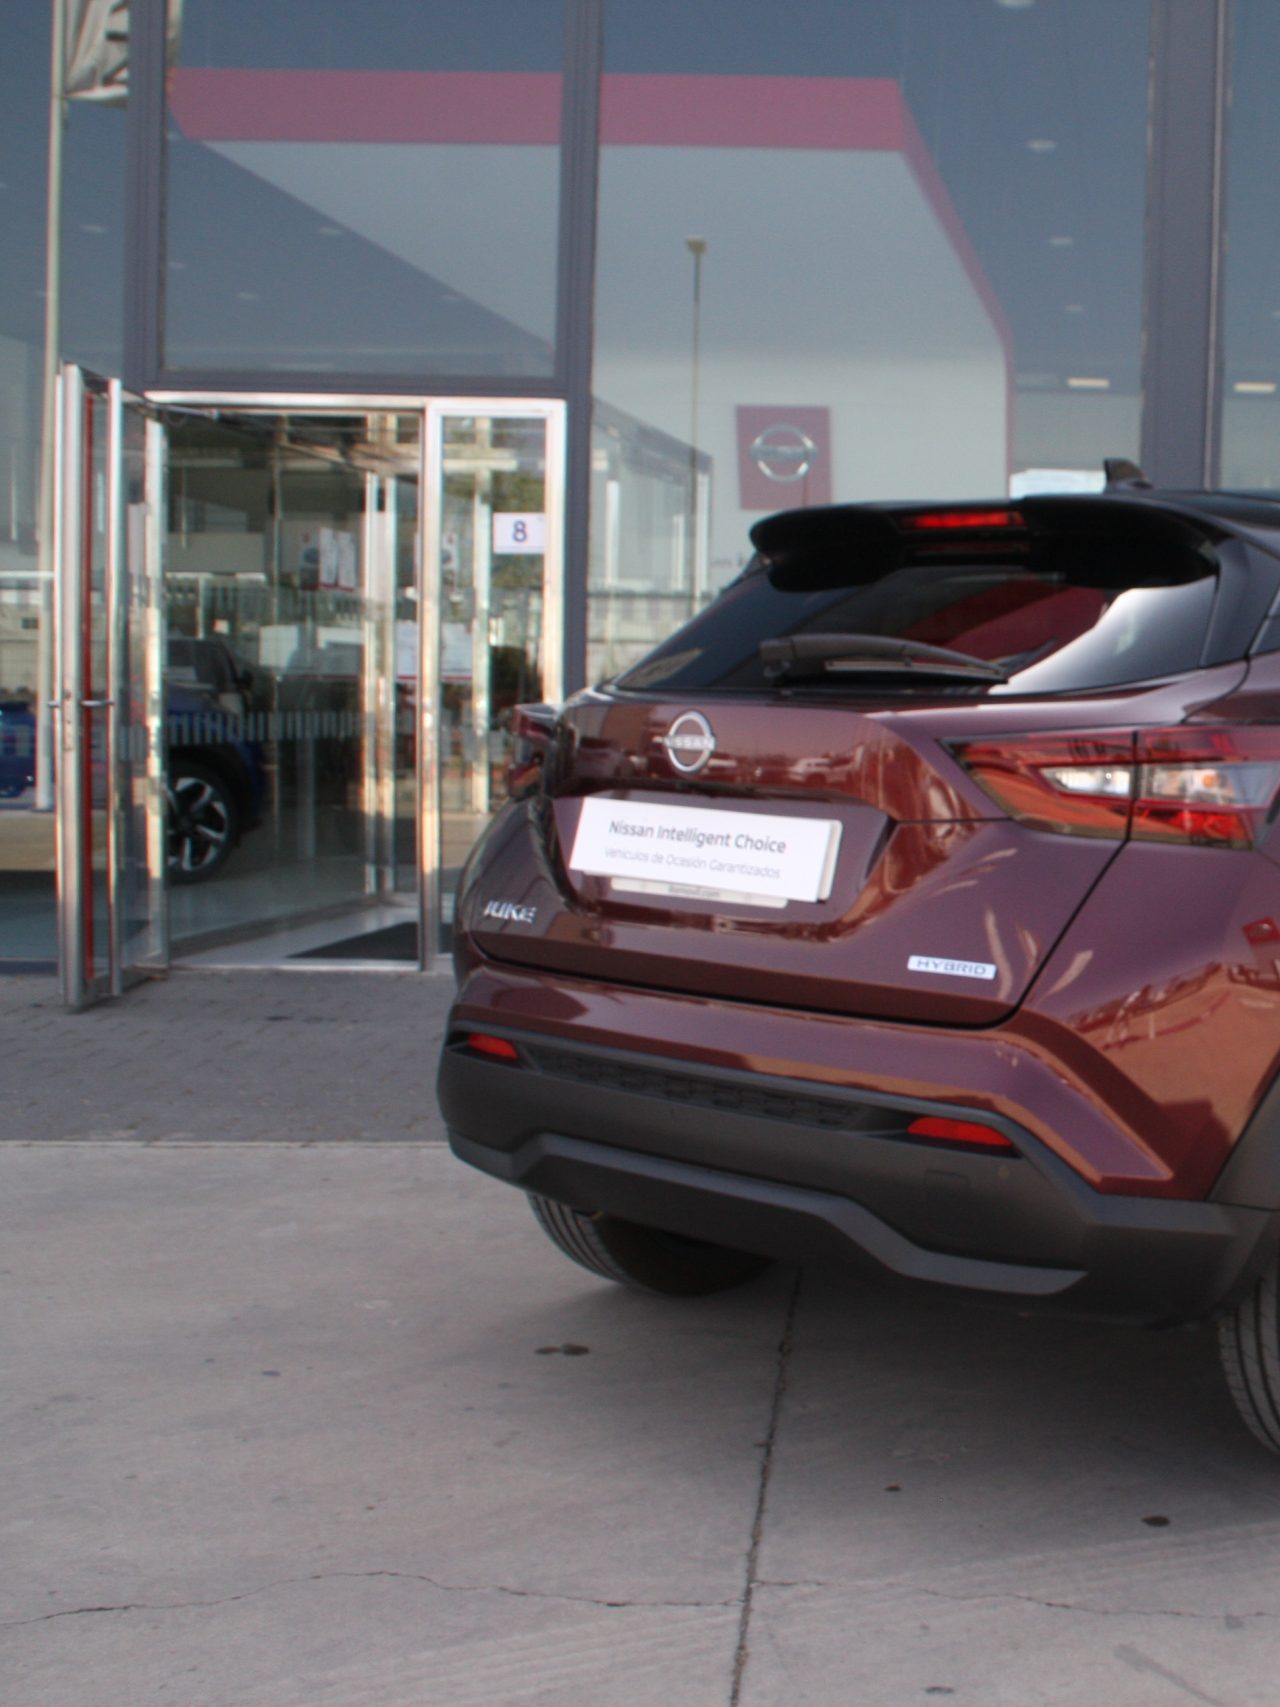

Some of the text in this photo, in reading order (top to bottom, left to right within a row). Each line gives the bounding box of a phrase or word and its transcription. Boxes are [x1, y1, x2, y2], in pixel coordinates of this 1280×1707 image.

[512, 520, 528, 543] 8
[608, 820, 786, 854] Nissan Intelligent Choice
[651, 853, 664, 864] de
[666, 854, 707, 869] Ocasión
[709, 858, 780, 879] Garantizados
[483, 900, 537, 924] JUKE
[917, 959, 987, 975] HYBRID
